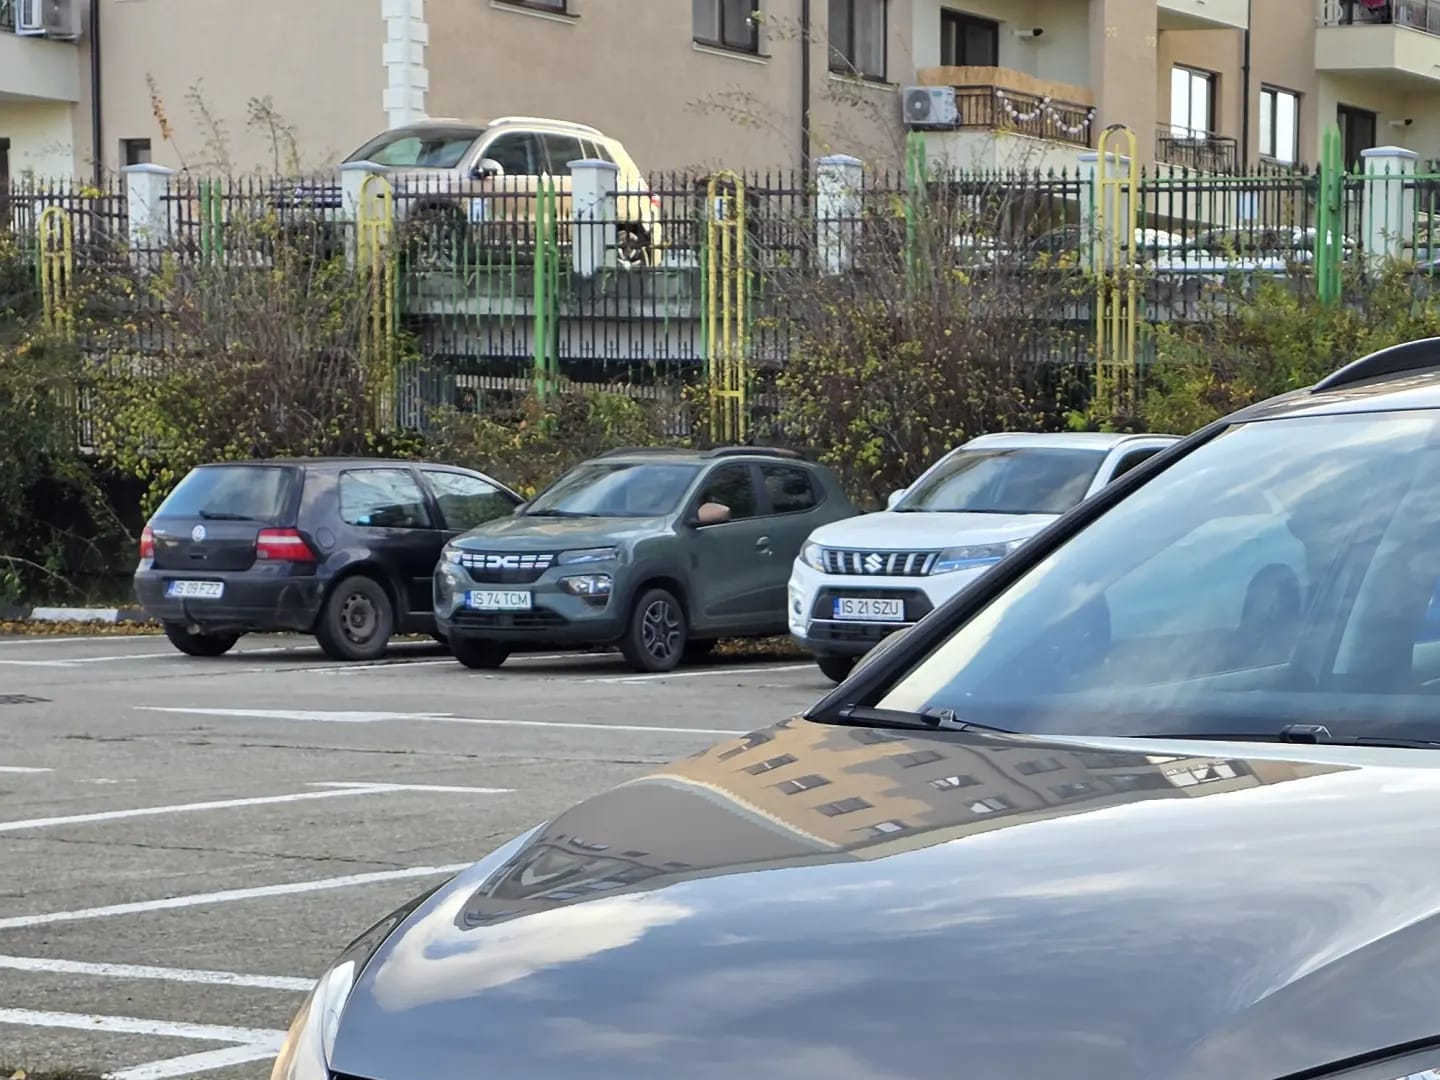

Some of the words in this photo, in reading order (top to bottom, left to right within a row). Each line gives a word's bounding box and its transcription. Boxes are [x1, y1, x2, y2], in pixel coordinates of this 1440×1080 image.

[473, 592, 484, 605] IS
[487, 592, 500, 605] 74
[503, 592, 529, 606] TCM
[842, 600, 854, 614] IS
[858, 600, 869, 614] 21
[872, 600, 899, 615] SZU
